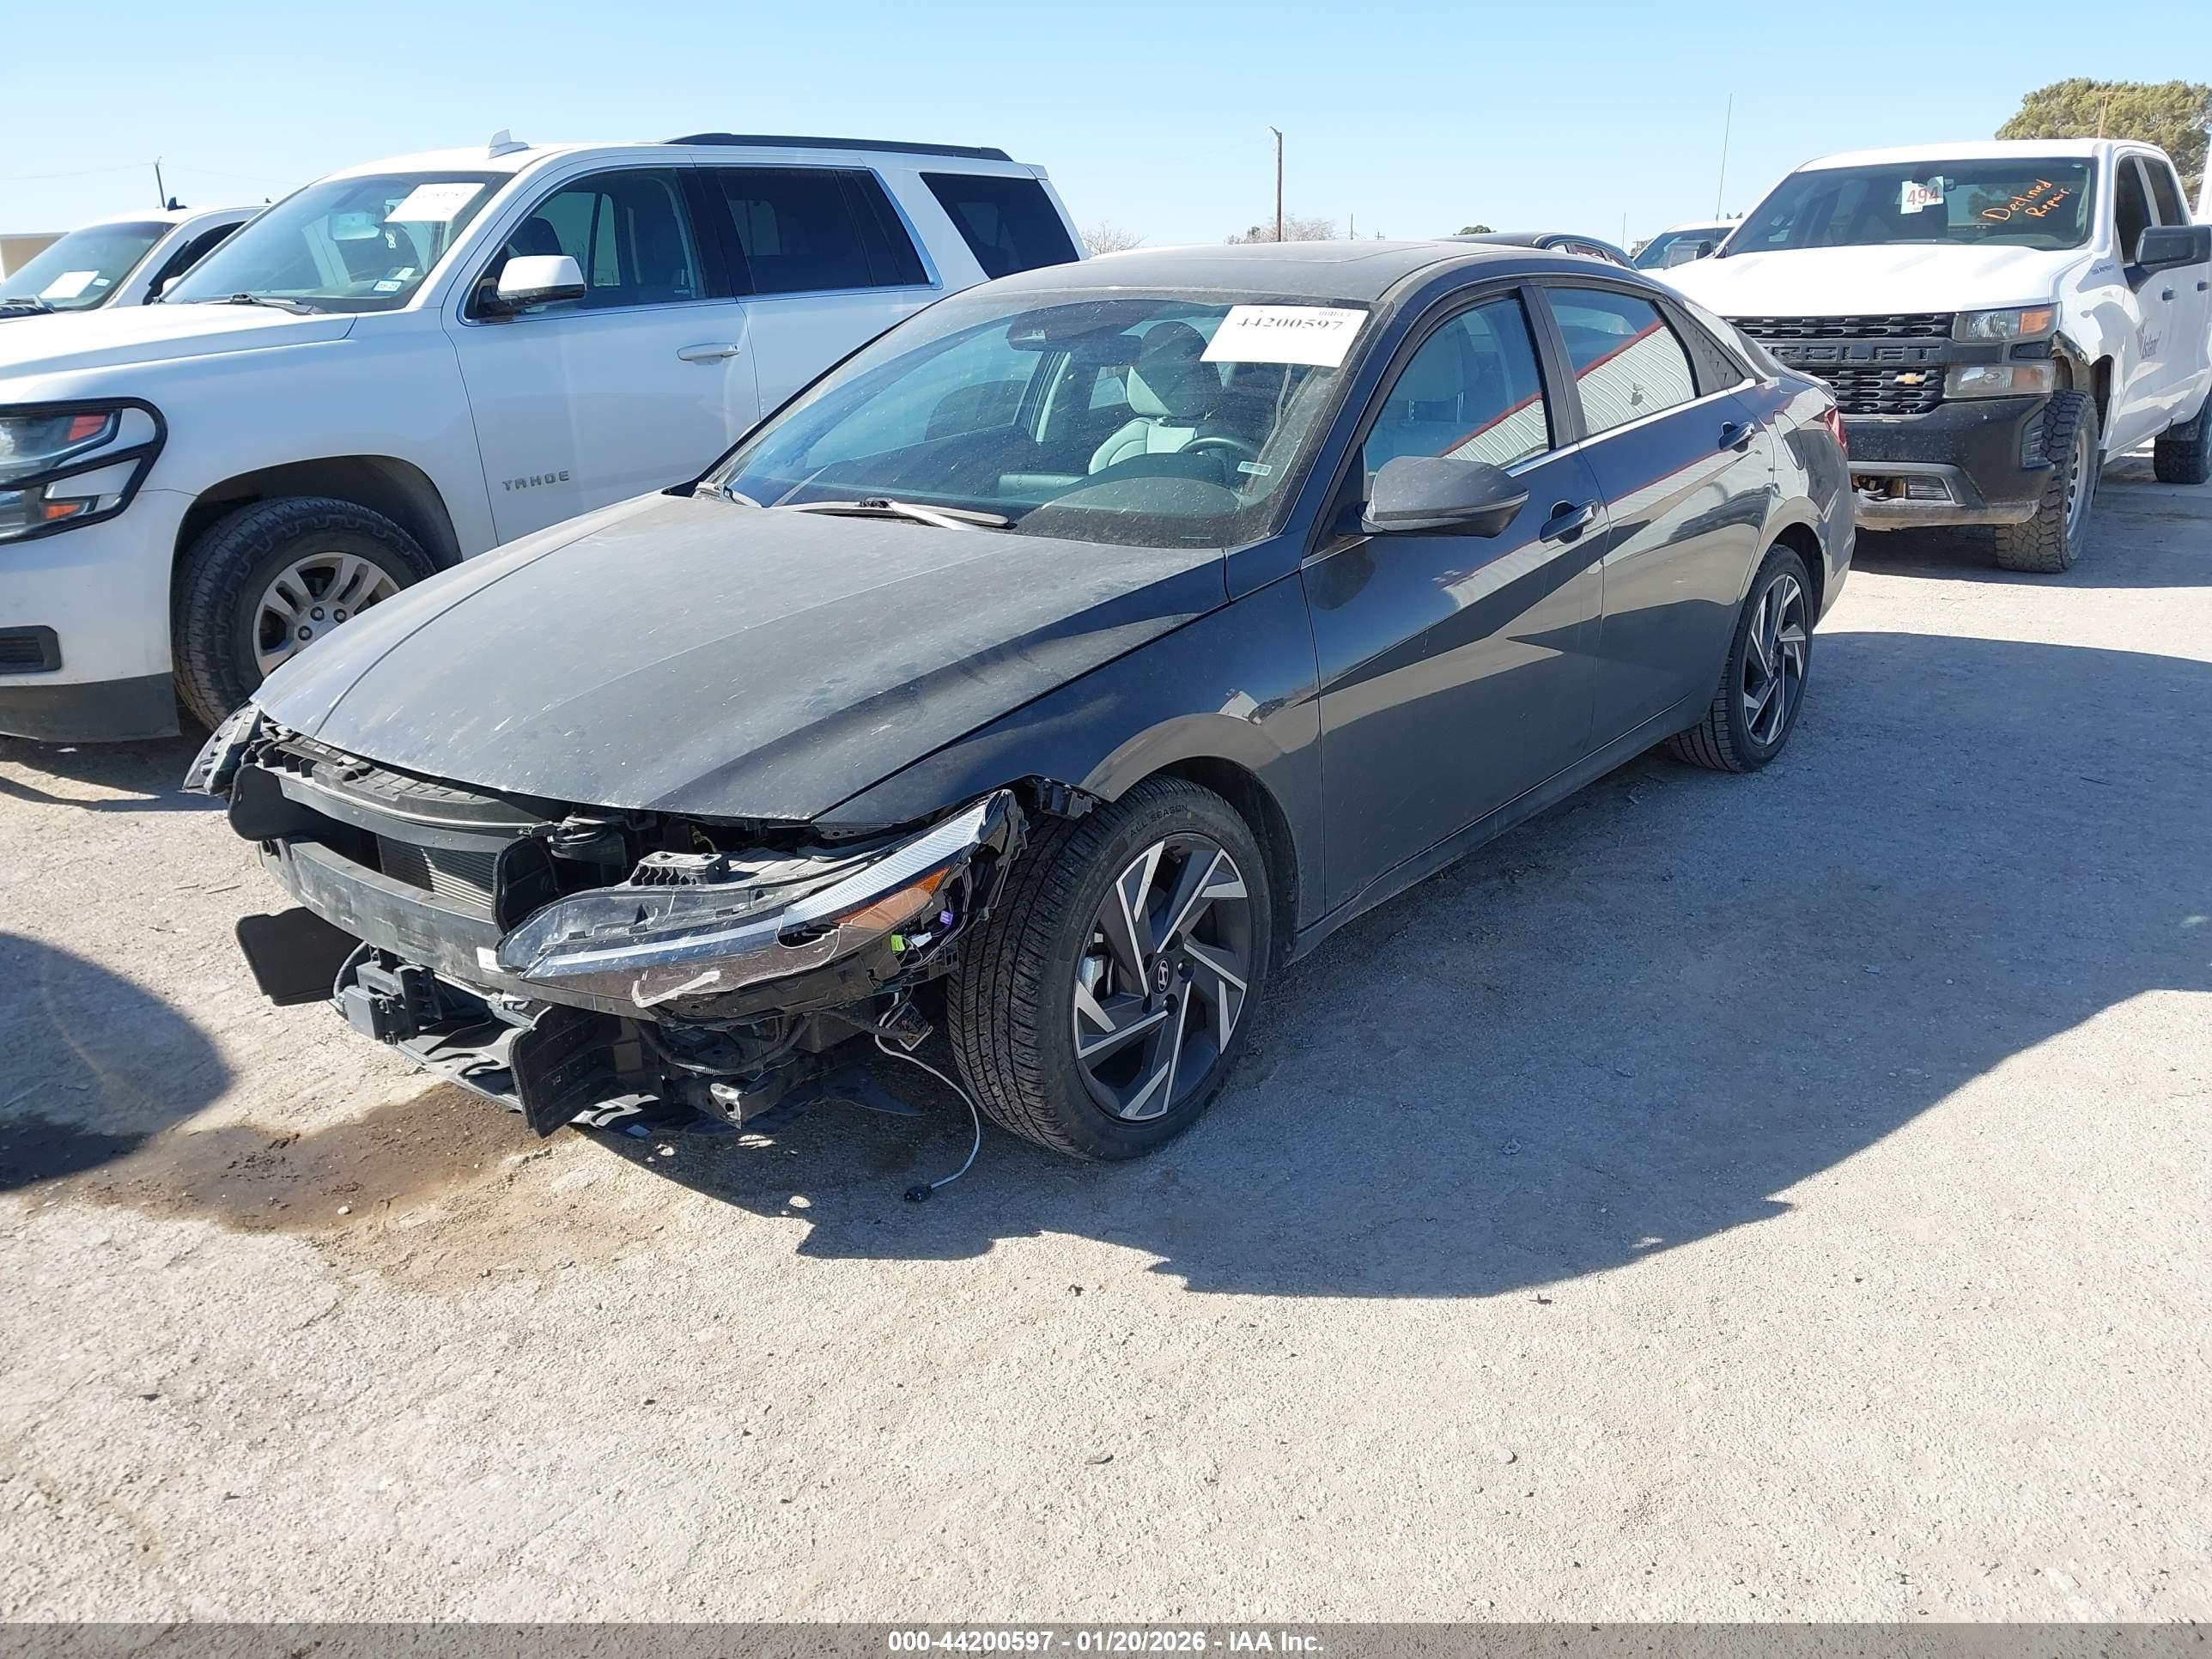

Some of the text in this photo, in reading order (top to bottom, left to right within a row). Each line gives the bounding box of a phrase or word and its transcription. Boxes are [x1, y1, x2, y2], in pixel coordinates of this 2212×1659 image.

[1906, 186, 1939, 205] 494
[1982, 179, 2053, 221] Declined
[1237, 317, 1345, 331] 44200597
[1764, 346, 1941, 362] ROLET
[501, 470, 570, 491] TAHOE
[1130, 804, 1189, 839] ALL SEASON
